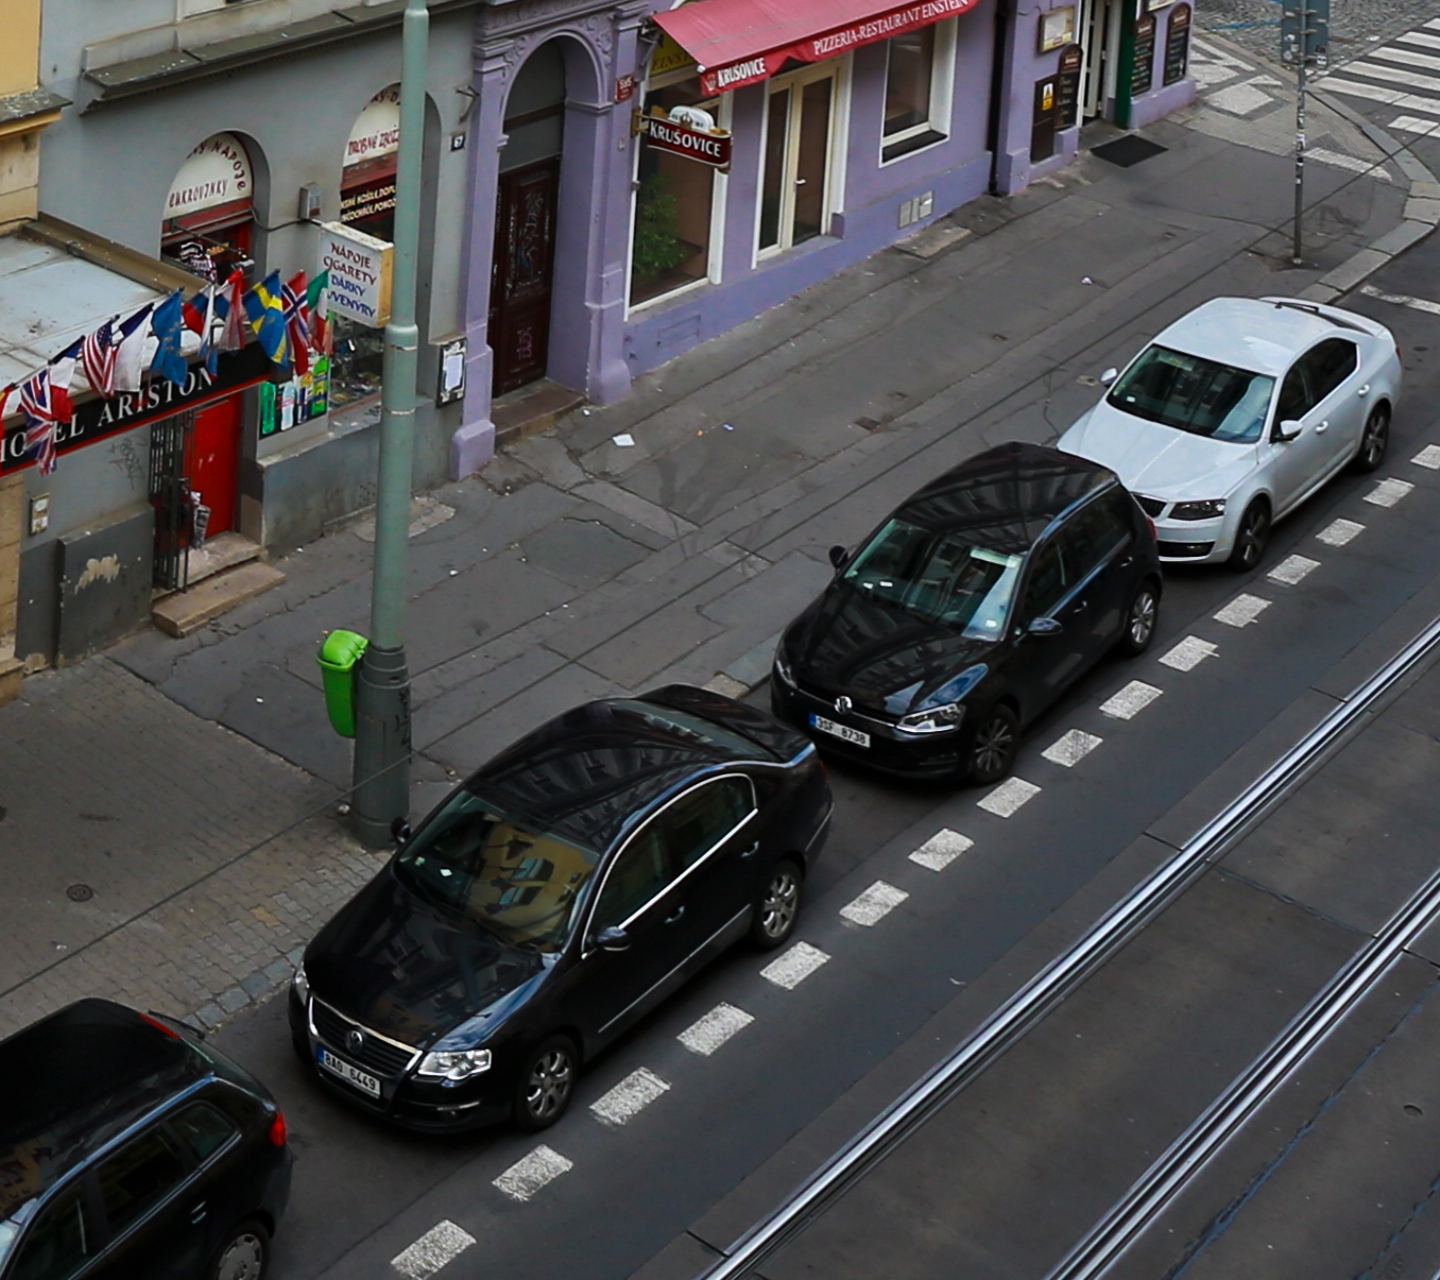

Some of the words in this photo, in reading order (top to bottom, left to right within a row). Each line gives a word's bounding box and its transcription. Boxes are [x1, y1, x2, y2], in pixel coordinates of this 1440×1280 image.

[813, 7, 921, 56] PIZZERIA-RESTAURANT
[649, 120, 722, 158] KRUŠOVICE
[330, 241, 371, 269] NÁPOJE
[330, 274, 366, 297] DÁRKY
[96, 366, 213, 427] ARISTON
[841, 727, 866, 744] 8738
[349, 1068, 376, 1091] 6449
